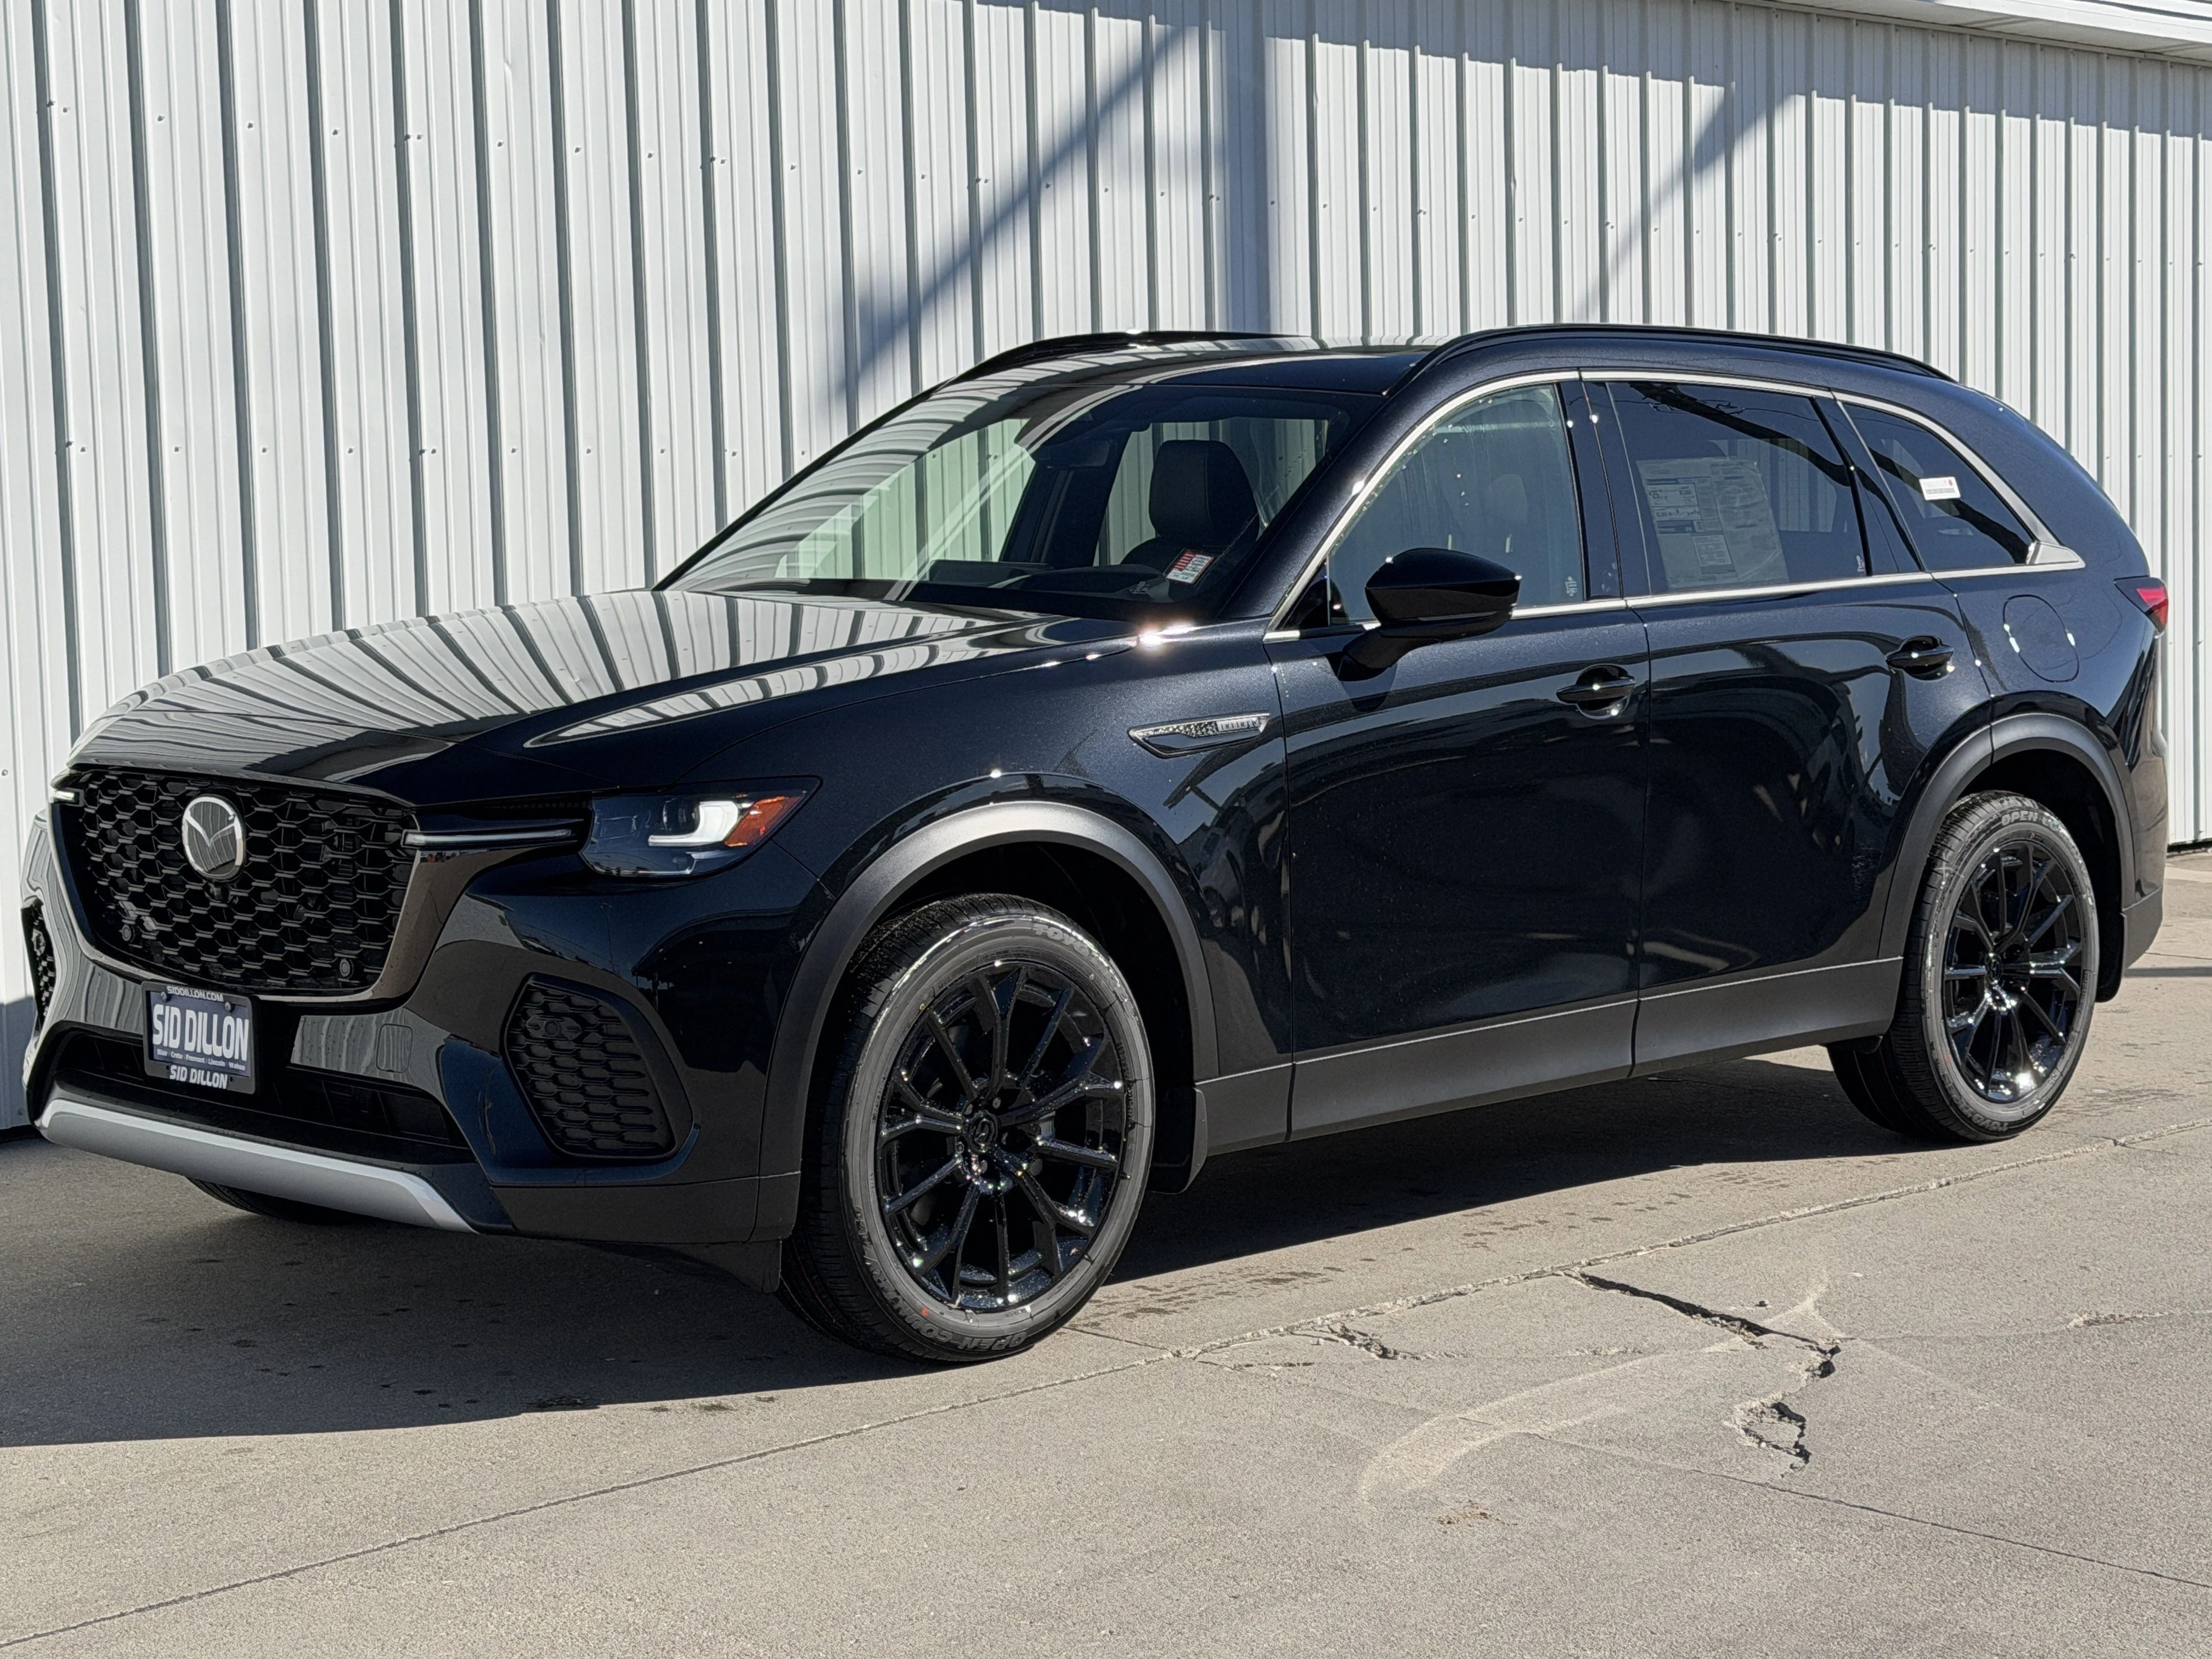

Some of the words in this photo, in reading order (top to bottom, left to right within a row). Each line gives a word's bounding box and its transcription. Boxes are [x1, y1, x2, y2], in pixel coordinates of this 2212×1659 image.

[2001, 810, 2039, 825] OPEN
[1033, 923, 1090, 956] TOYO
[167, 985, 224, 1002] SIDDILLON.COM
[152, 1003, 181, 1049] SID
[184, 1008, 249, 1062] DILLON
[170, 1065, 188, 1082] SID
[189, 1068, 228, 1090] DILLON
[957, 1331, 1028, 1350] OPEN
